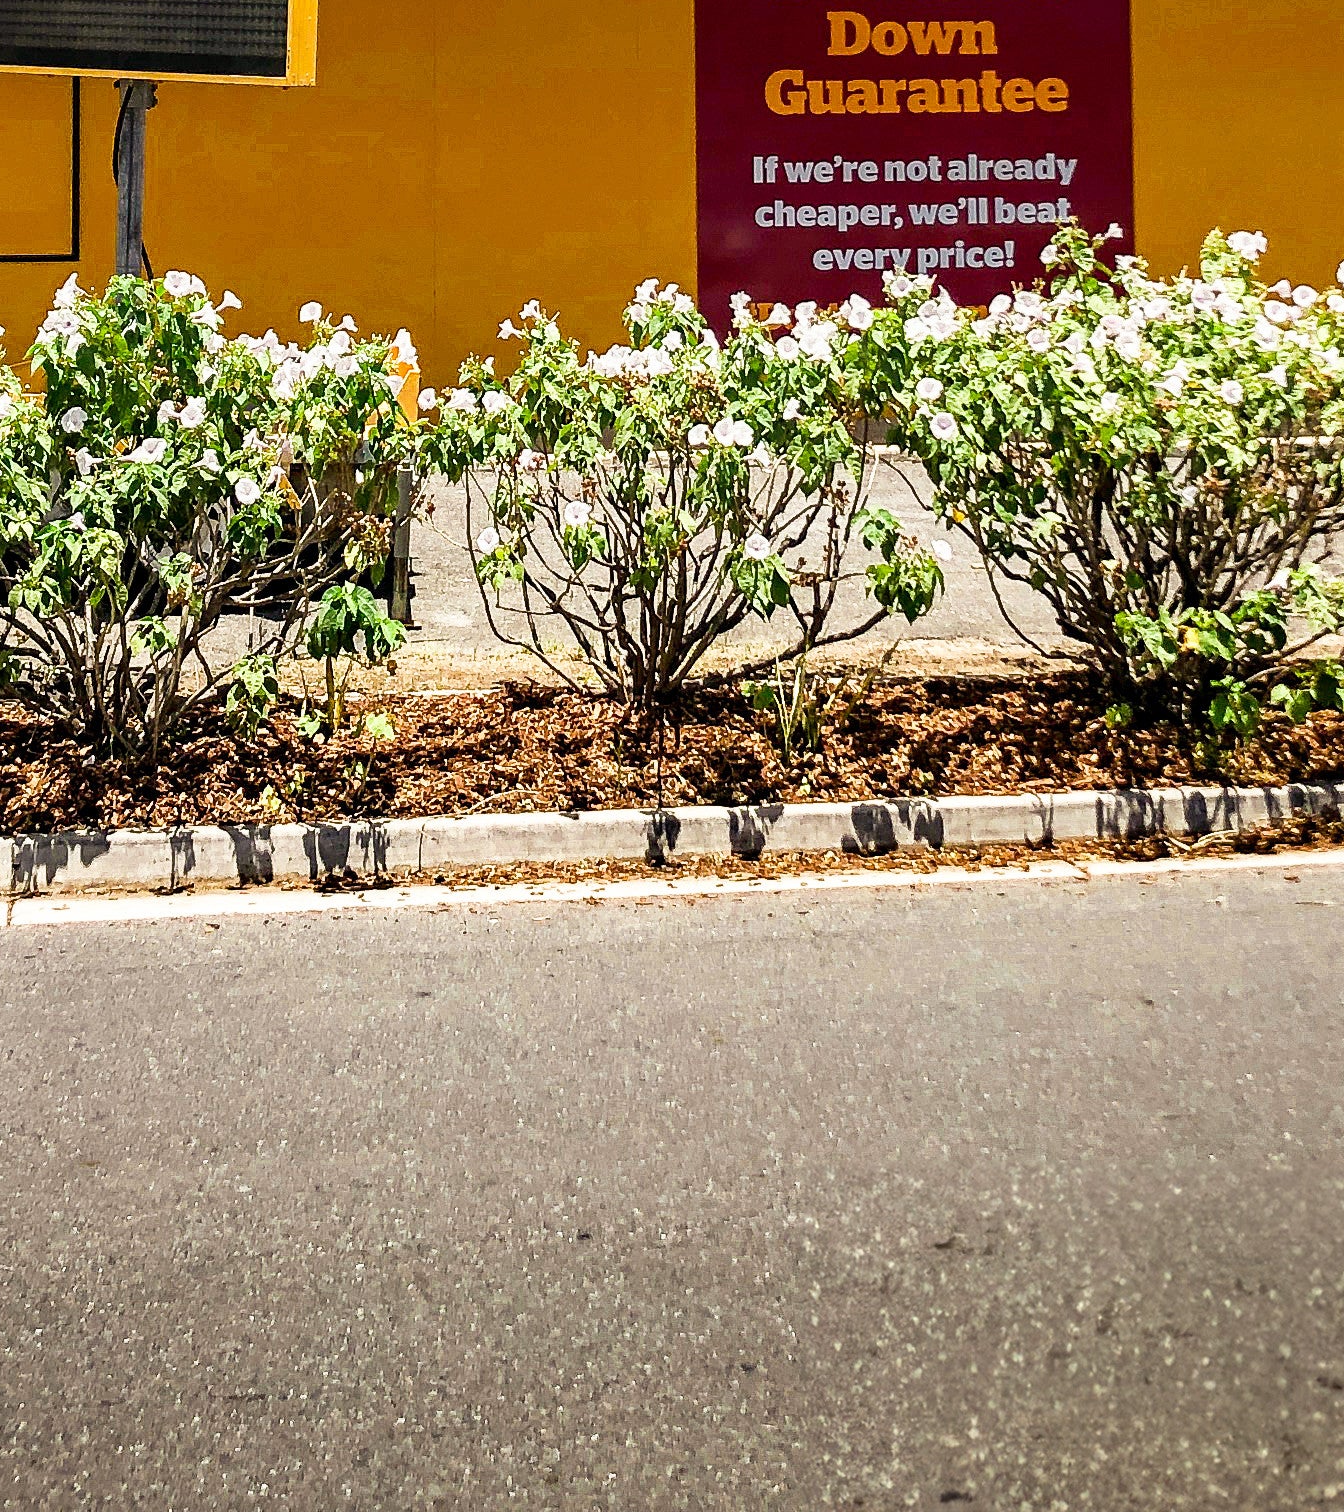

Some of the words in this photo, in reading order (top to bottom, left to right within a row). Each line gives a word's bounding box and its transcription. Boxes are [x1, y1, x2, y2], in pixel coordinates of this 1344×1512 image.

[826, 10, 998, 56] Down
[764, 69, 1070, 116] Guarantee
[752, 156, 779, 184] If
[784, 155, 879, 183] we're
[884, 155, 943, 182] not
[946, 152, 1079, 186] already
[754, 199, 904, 232] cheaper,
[908, 196, 988, 225] we'll
[994, 196, 1072, 224] beat
[812, 246, 909, 272] every
[916, 239, 1016, 275] price!
